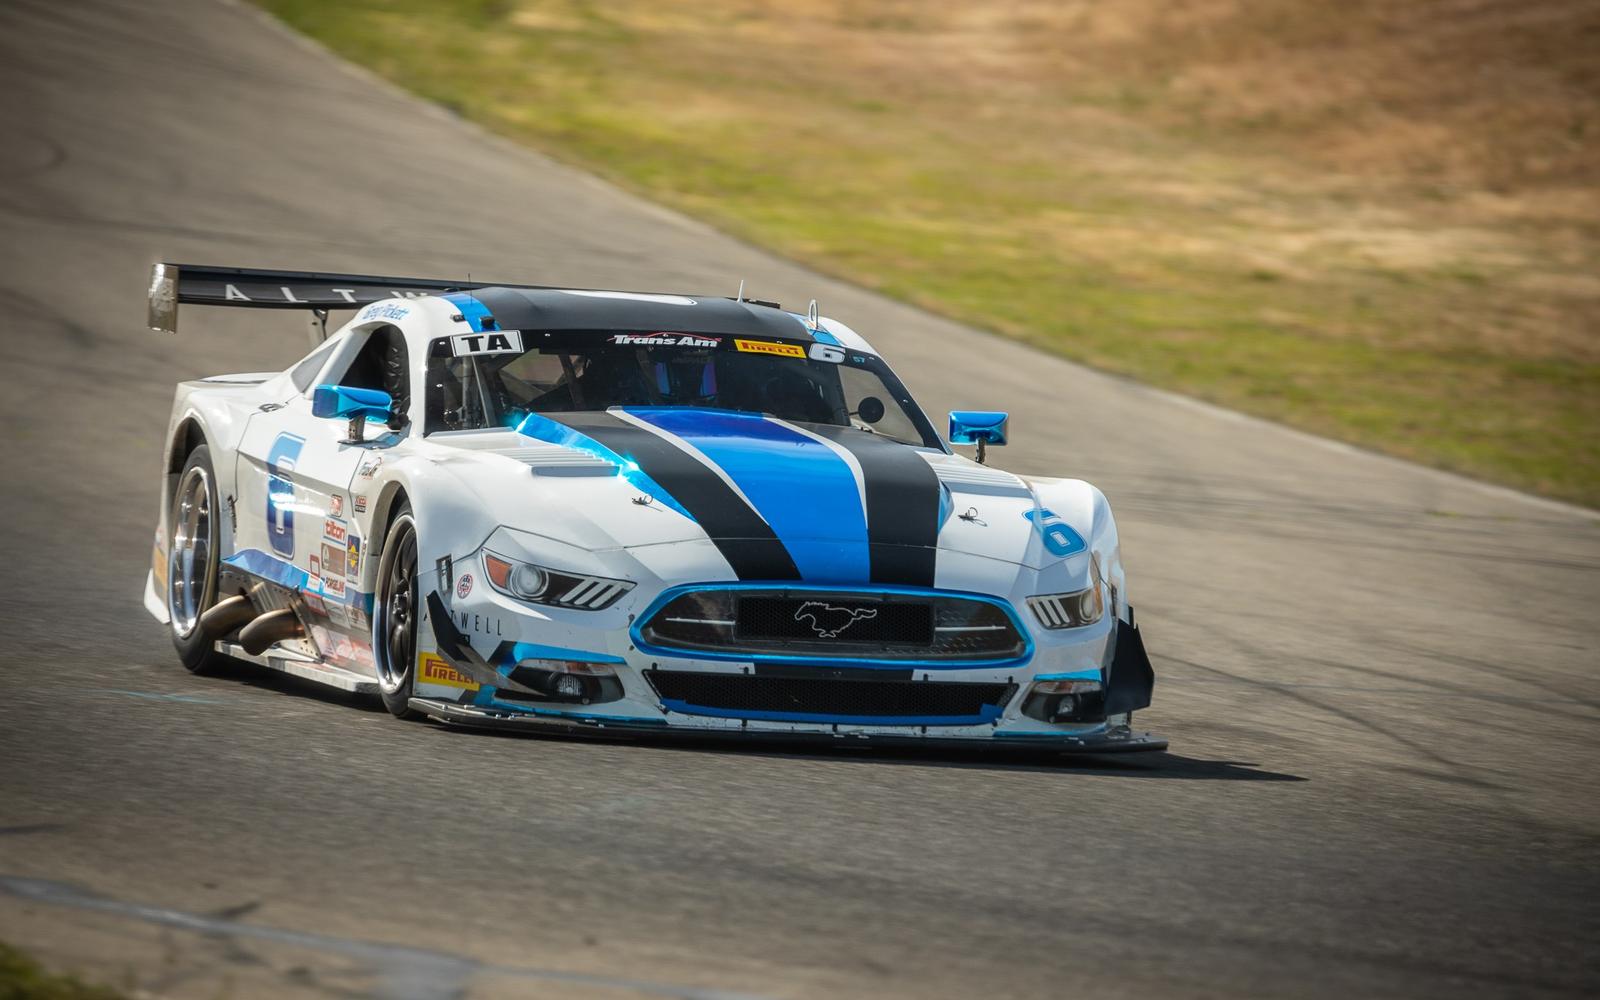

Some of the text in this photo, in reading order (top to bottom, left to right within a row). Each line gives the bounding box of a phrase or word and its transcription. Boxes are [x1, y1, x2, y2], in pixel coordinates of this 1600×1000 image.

[461, 334, 512, 352] TA
[614, 335, 718, 347] Trans Am
[741, 341, 800, 355] PIRELLI
[808, 343, 846, 363] 6
[1022, 508, 1088, 558] 6
